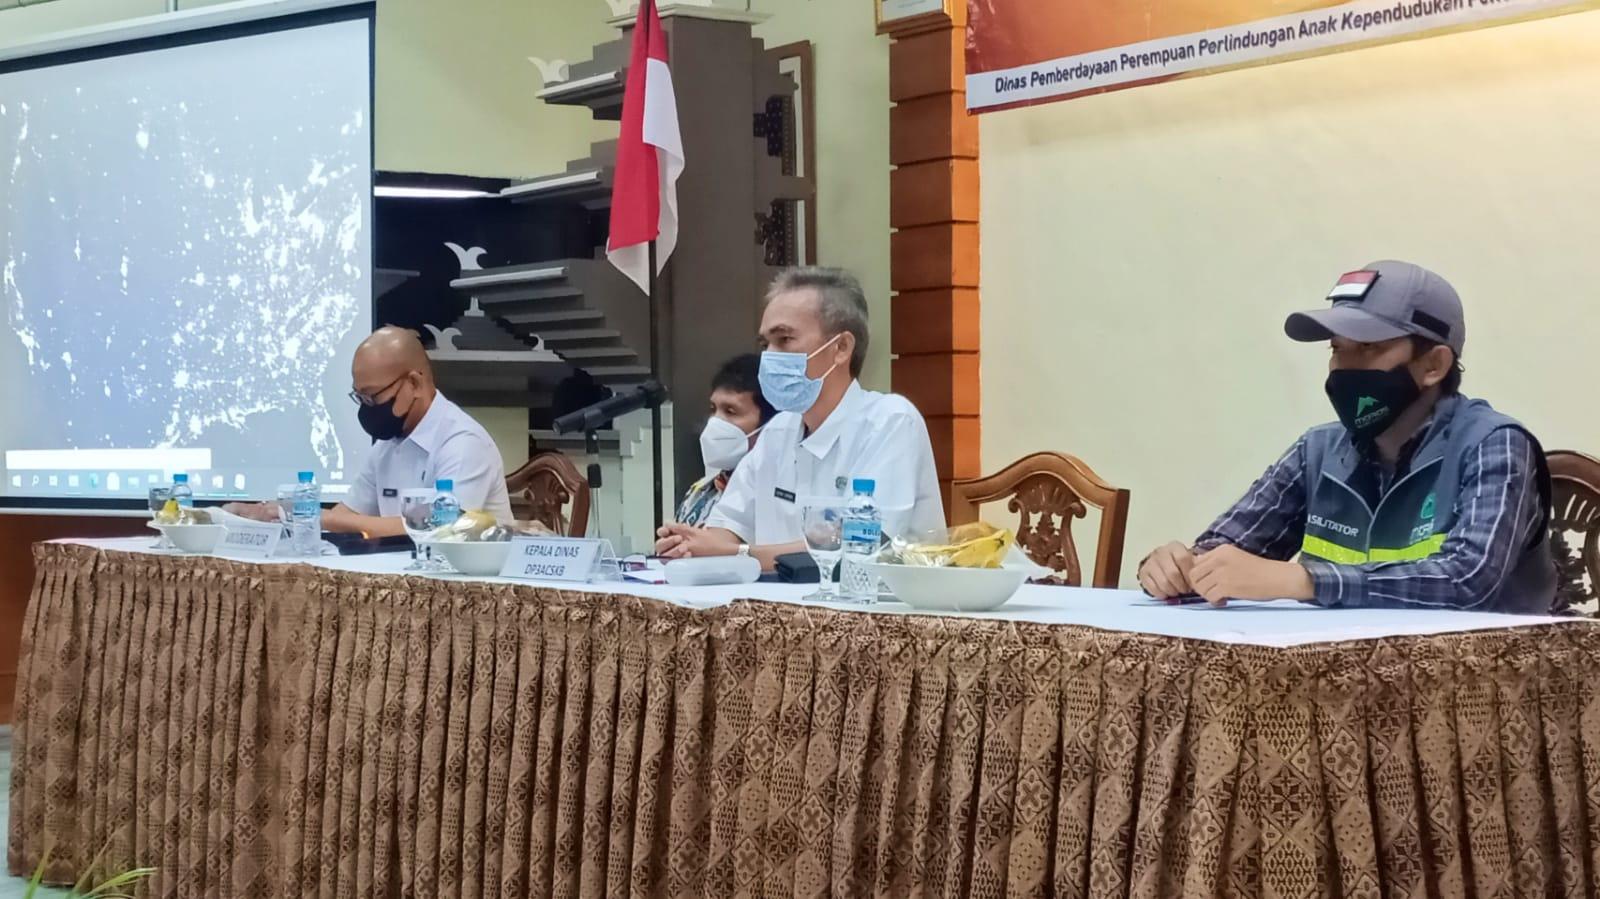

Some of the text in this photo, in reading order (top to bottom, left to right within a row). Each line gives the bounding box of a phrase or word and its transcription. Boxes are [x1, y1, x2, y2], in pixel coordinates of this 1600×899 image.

[995, 0, 1464, 93] Dinas Pemberdayaan Perempuan Perlindungan Anak Kependudukan
[525, 544, 580, 558] KEPALA DINAS
